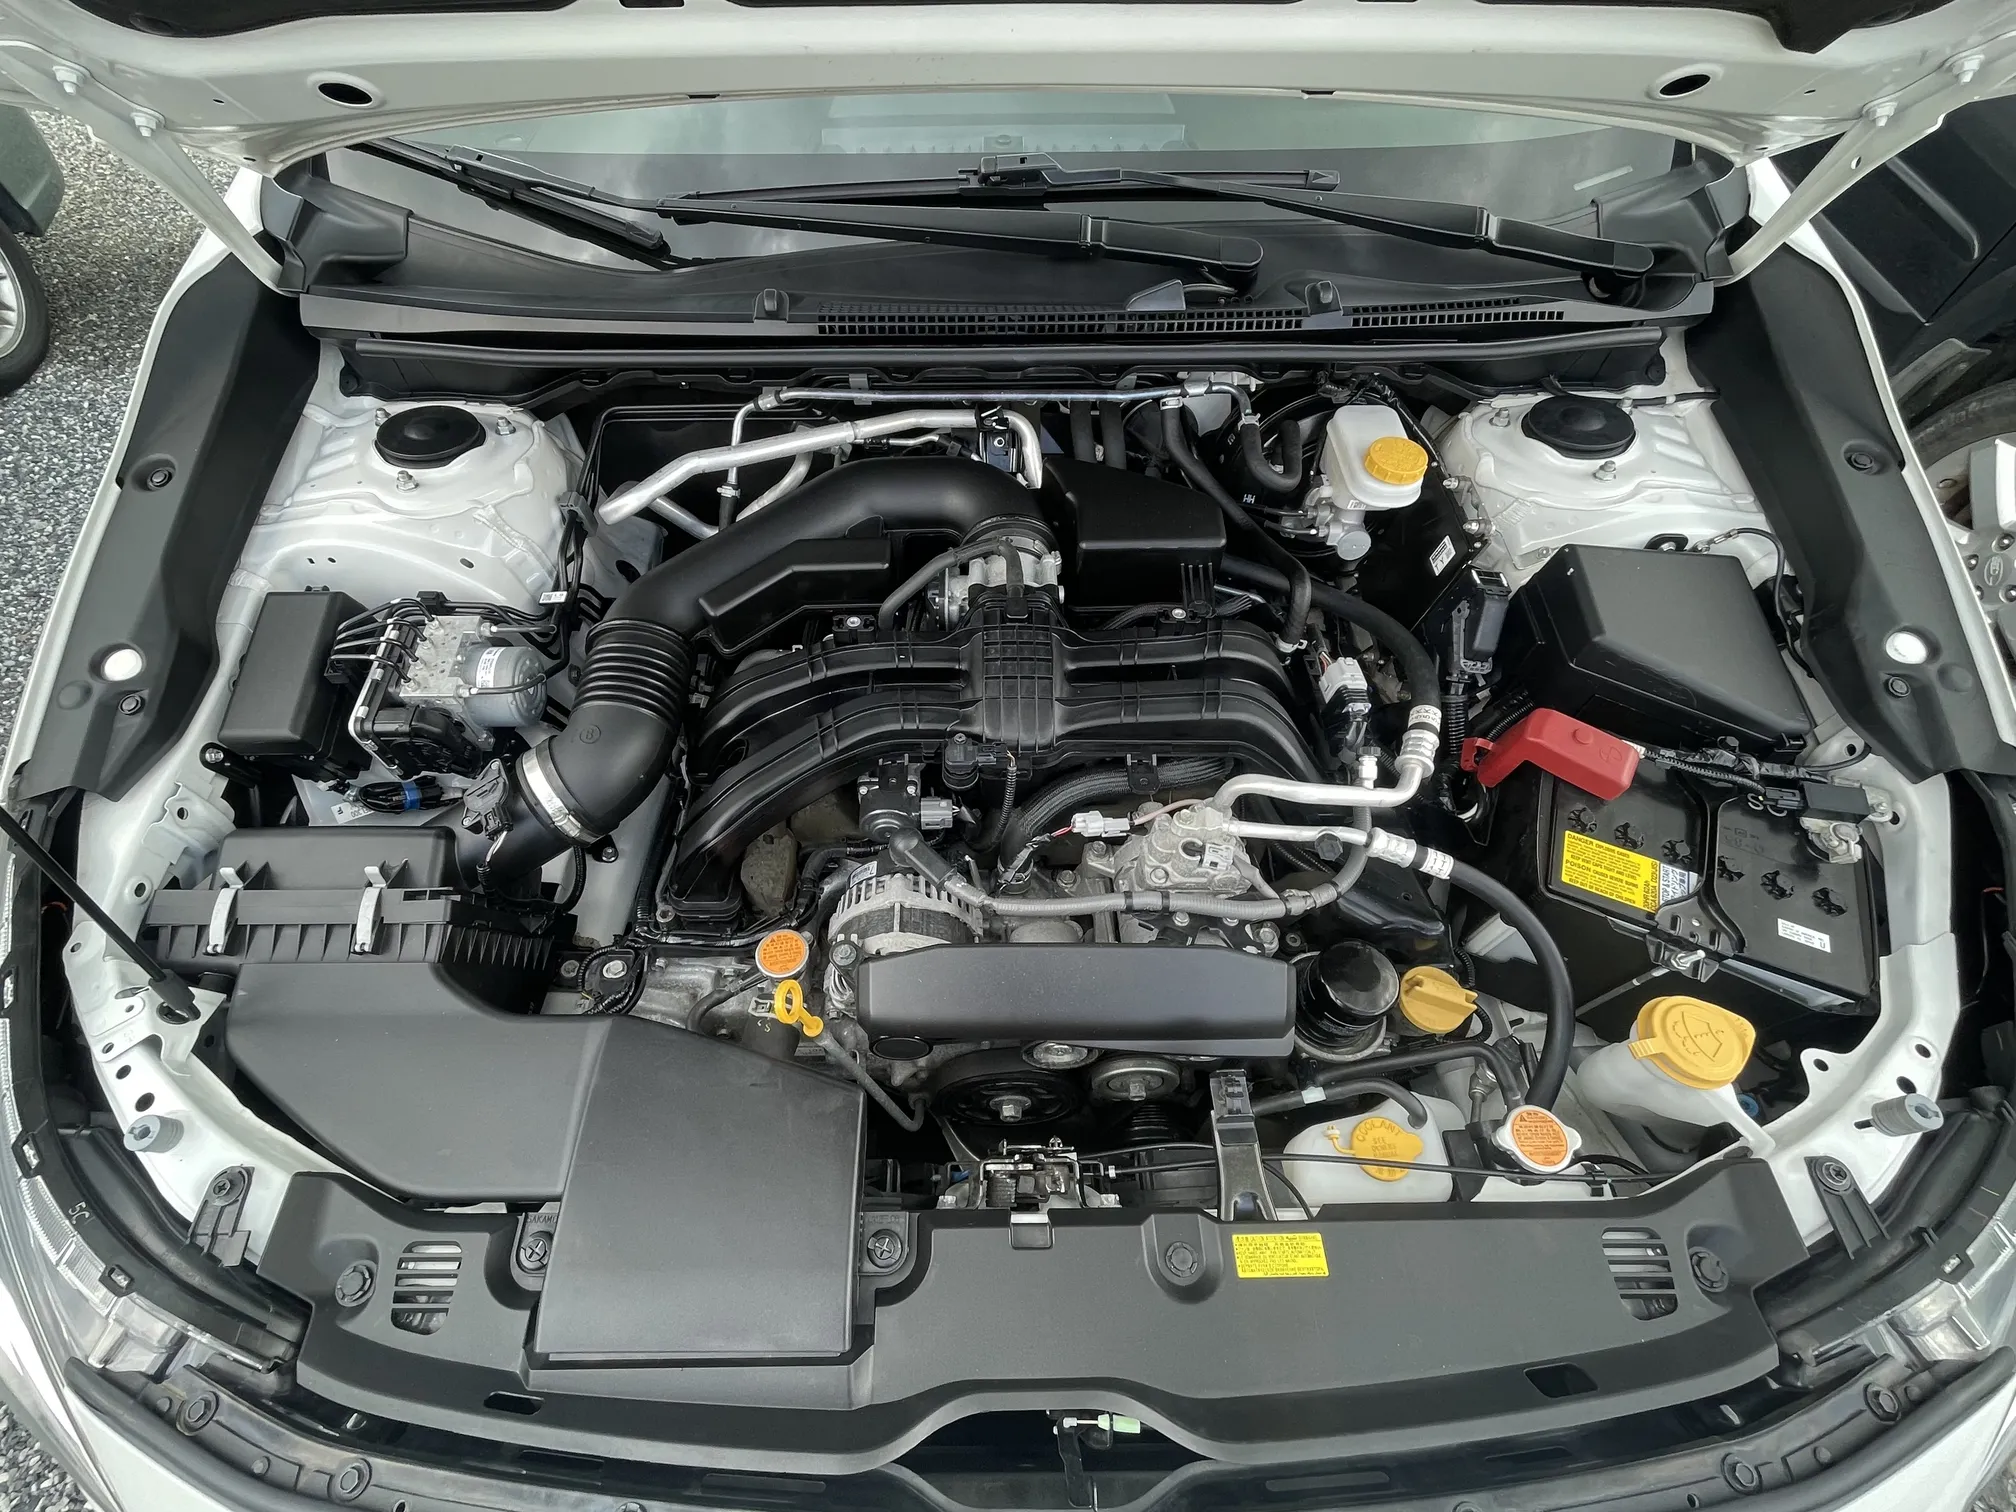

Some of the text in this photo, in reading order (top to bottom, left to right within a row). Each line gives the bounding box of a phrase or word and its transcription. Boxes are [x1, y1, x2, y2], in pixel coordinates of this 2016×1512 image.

[1567, 833, 1593, 846] DANGER
[1565, 859, 1591, 872] POISON
[1662, 865, 1670, 883] START
[1594, 886, 1608, 895] REACH
[1615, 894, 1635, 904] CHILDREN
[1356, 1119, 1401, 1142] COOLANT
